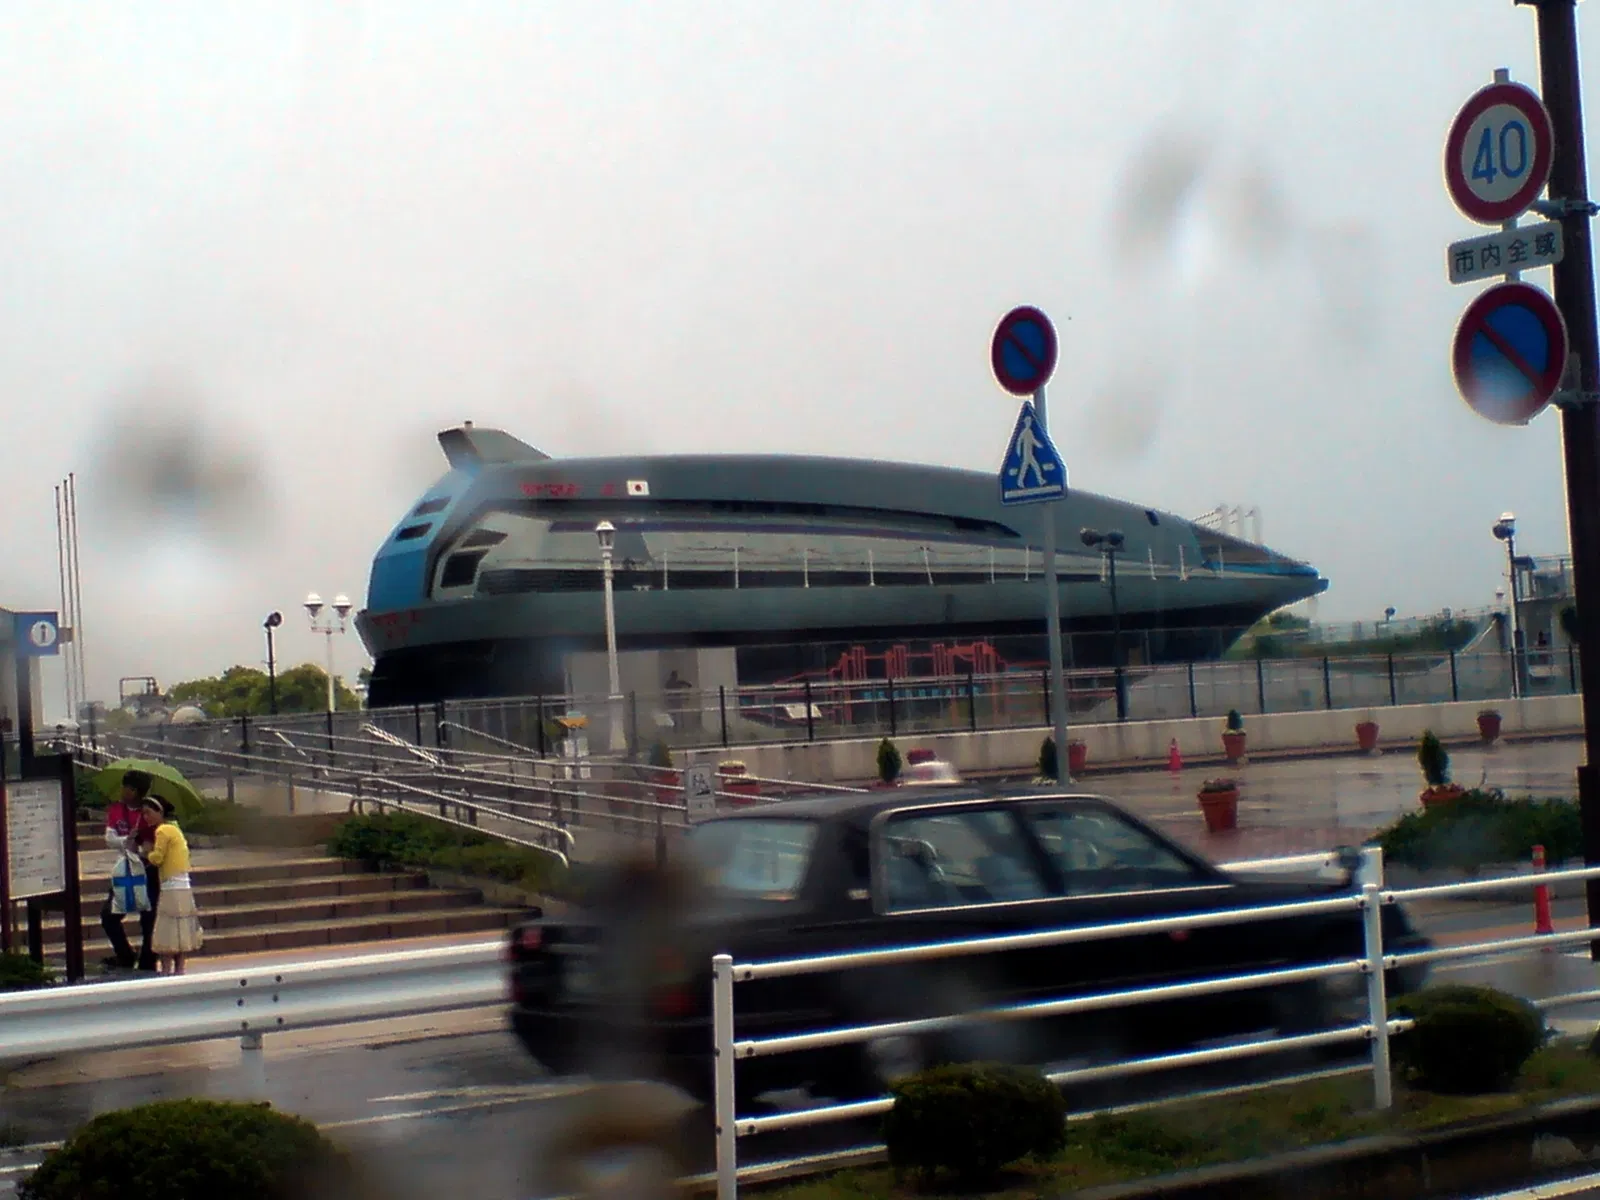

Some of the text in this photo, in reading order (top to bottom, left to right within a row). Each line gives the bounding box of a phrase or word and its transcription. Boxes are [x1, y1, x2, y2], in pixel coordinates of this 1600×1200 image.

[1471, 120, 1528, 184] 40
[1453, 231, 1557, 275] 市内全域
